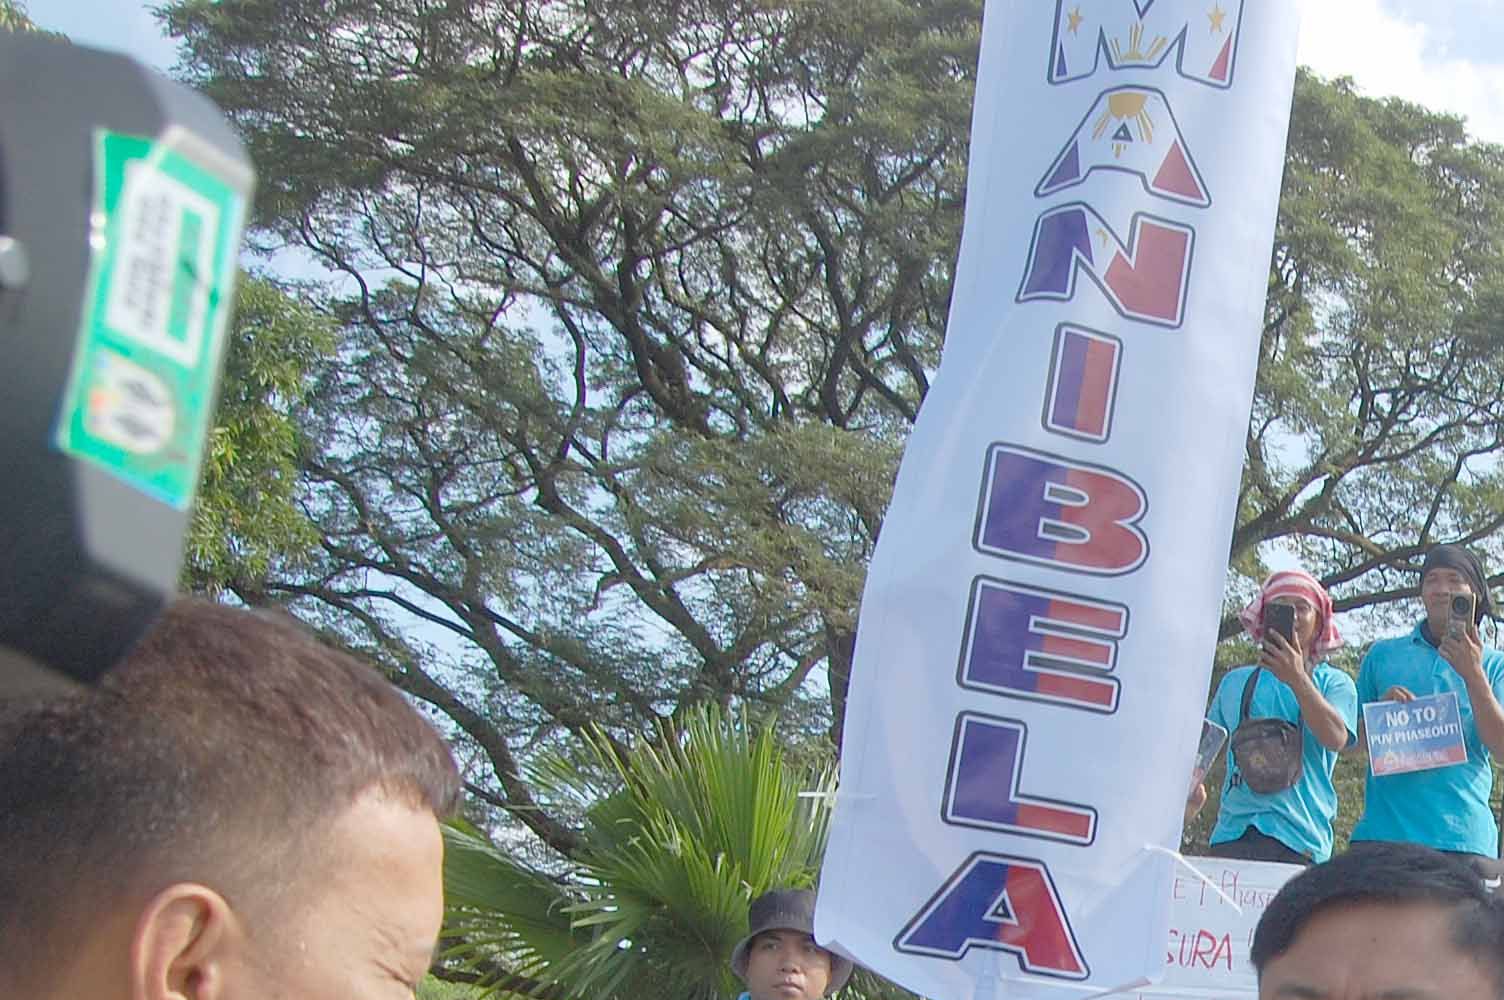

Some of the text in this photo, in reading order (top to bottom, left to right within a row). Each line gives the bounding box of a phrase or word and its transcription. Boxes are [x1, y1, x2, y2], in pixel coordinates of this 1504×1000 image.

[891, 0, 1244, 982] MANIBELA
[1386, 706, 1436, 728] NO TO
[1395, 723, 1459, 743] PHASEOUT!
[1167, 929, 1232, 971] SURA
